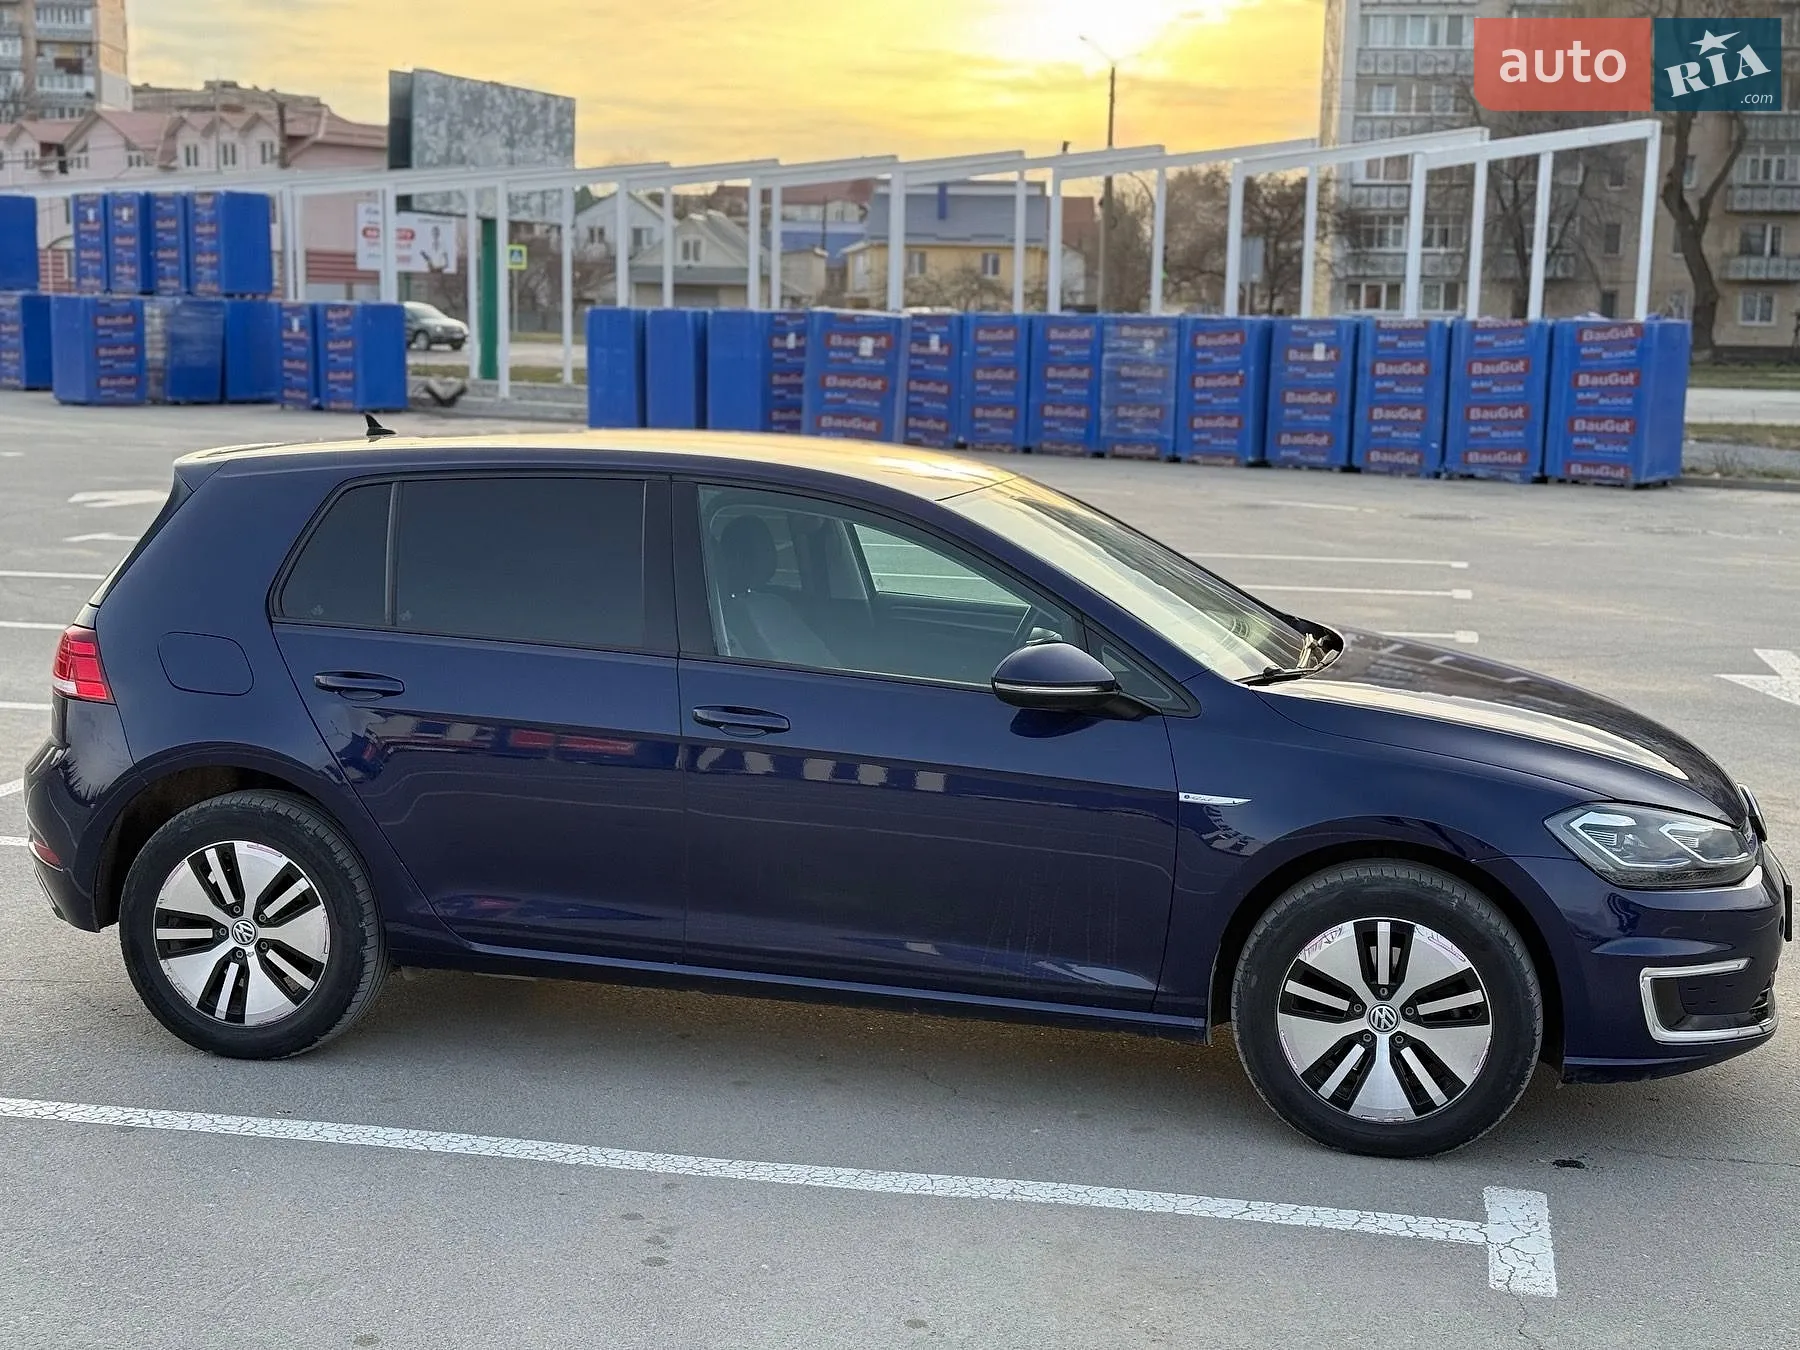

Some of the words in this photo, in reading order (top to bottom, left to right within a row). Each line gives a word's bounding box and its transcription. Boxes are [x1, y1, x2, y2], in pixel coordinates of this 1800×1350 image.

[829, 334, 887, 348] Bauut
[1582, 327, 1636, 341] BauGut
[1288, 349, 1337, 361] Bauut
[1375, 362, 1425, 375] BauGut
[1472, 360, 1525, 374] BauGut
[825, 375, 883, 390] BauGut
[1578, 373, 1635, 386] BauGut
[1285, 392, 1333, 404] BauGut
[1372, 407, 1422, 421] BauGut
[1469, 406, 1524, 420] BauGut
[821, 416, 878, 432] BauGut
[1574, 419, 1631, 432] BauGut
[1369, 451, 1420, 464] BauGut
[1468, 452, 1523, 463] BauGut
[1570, 463, 1626, 478] BauGut
